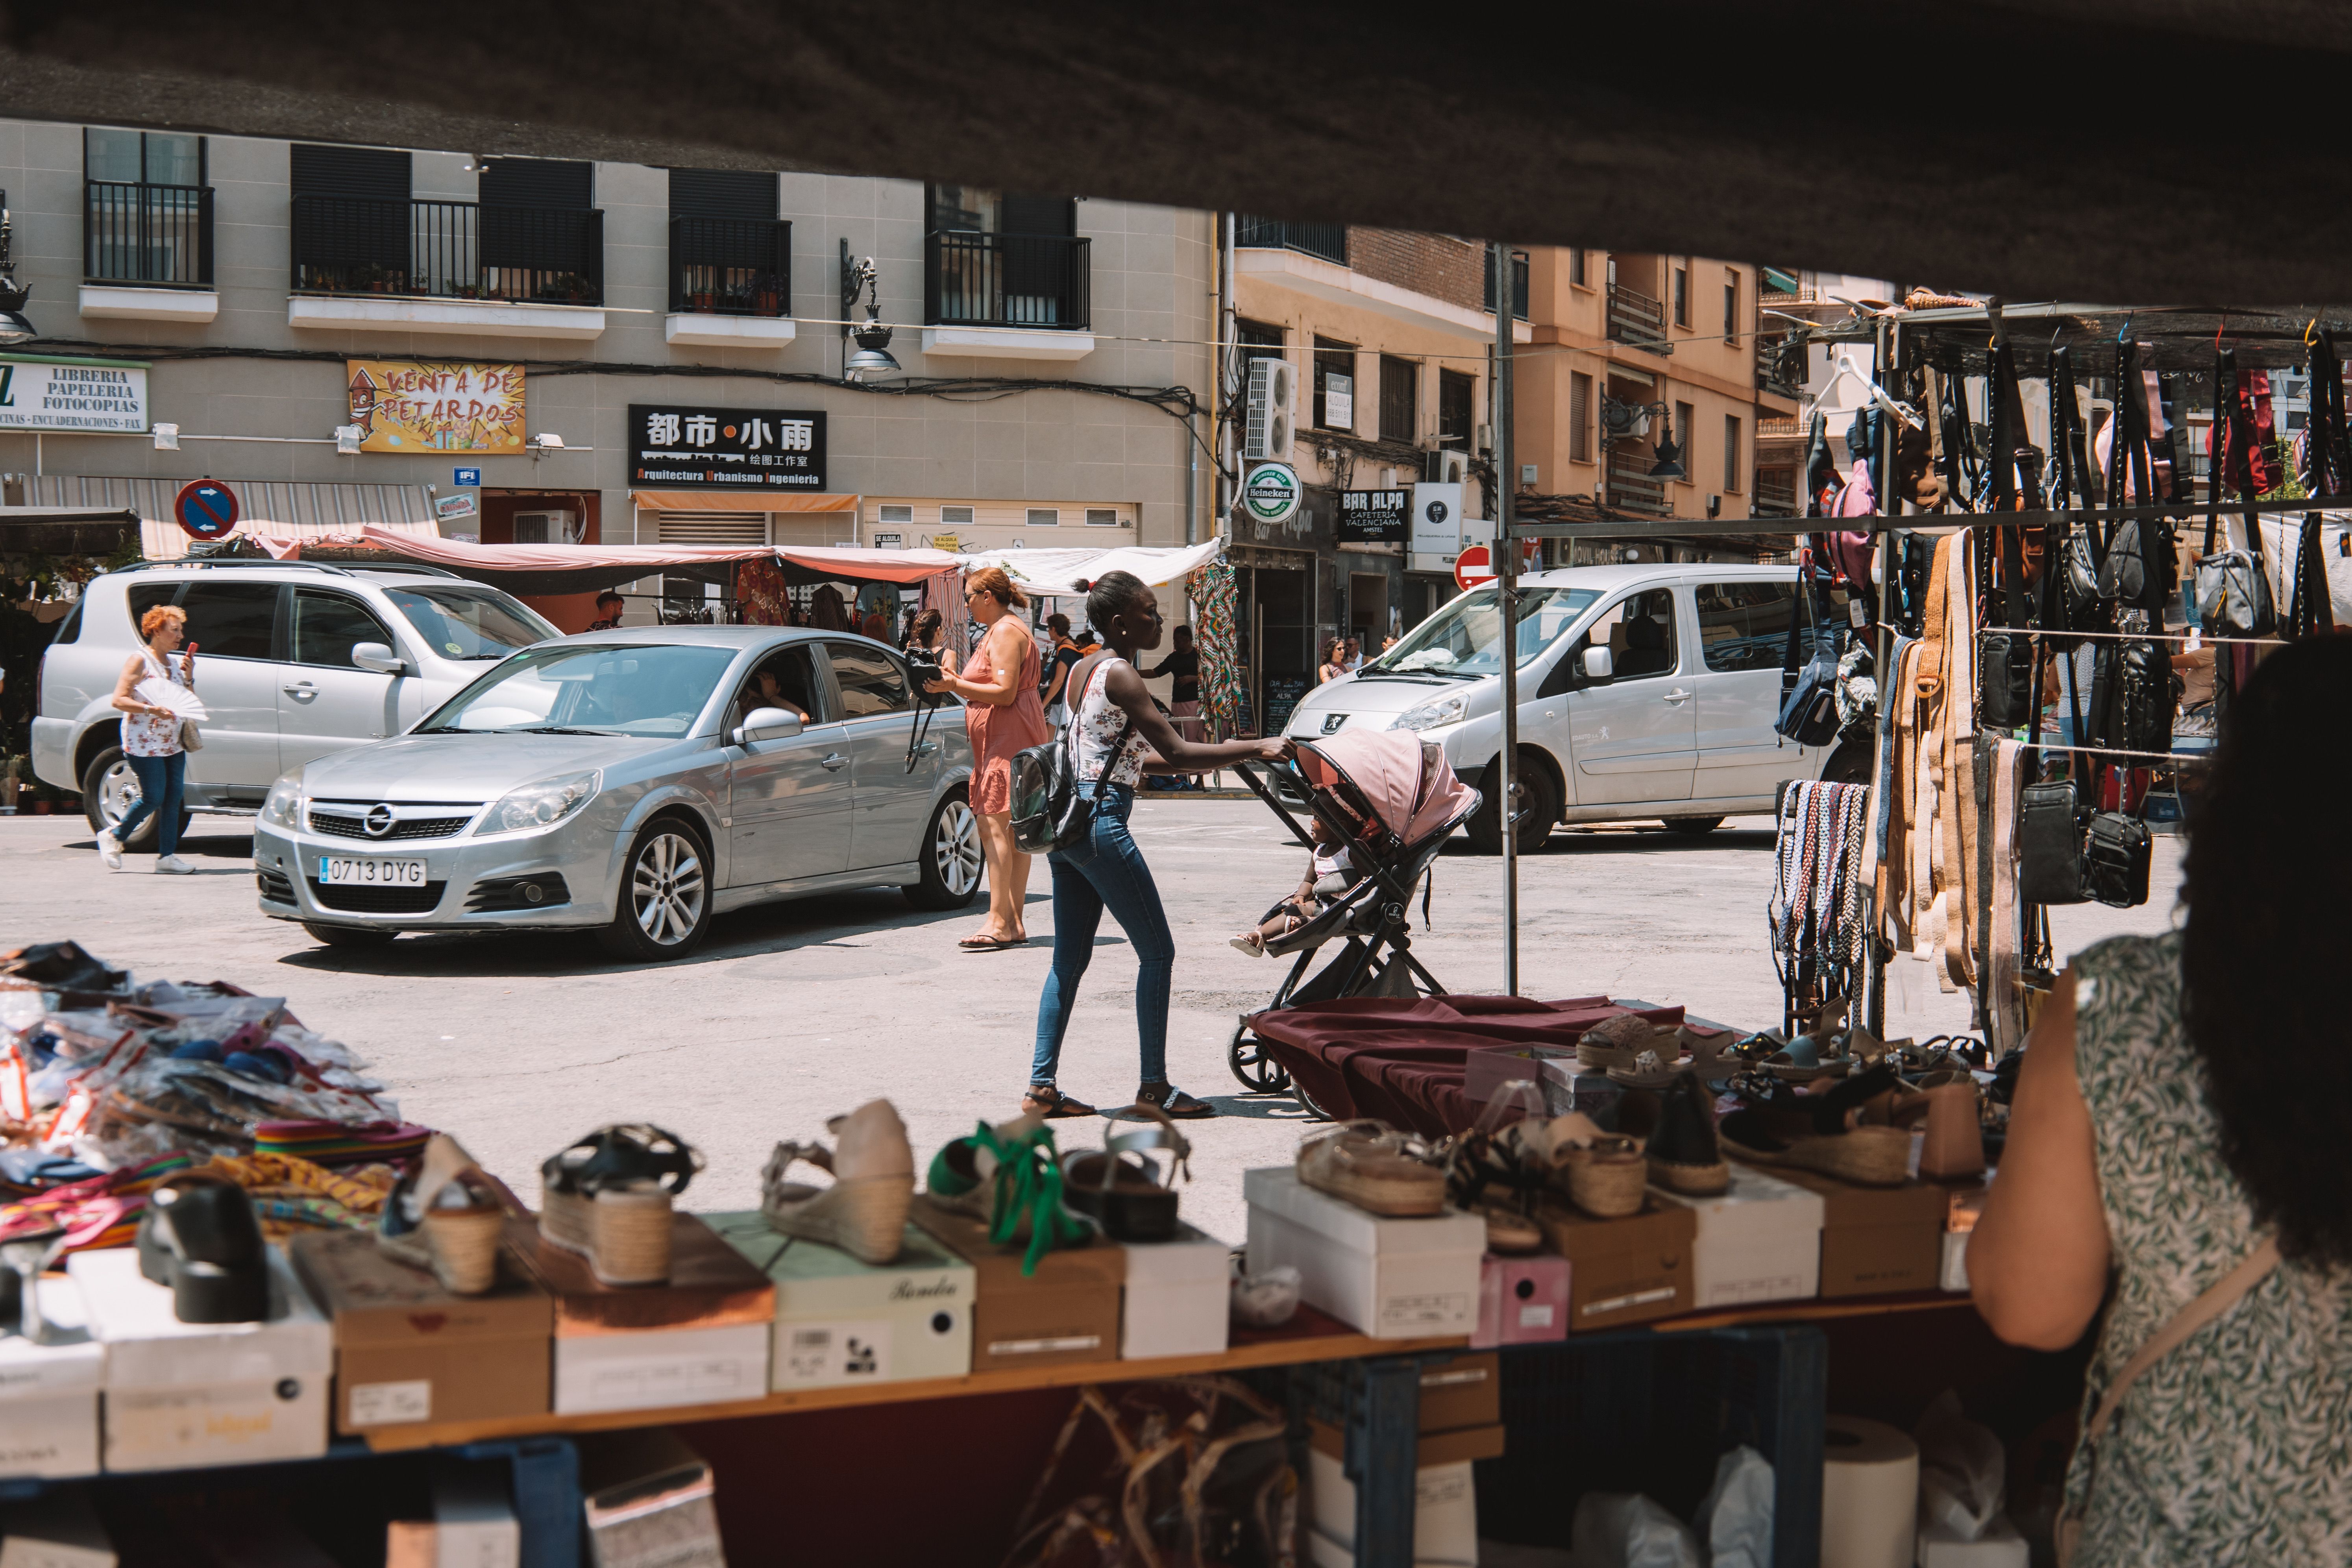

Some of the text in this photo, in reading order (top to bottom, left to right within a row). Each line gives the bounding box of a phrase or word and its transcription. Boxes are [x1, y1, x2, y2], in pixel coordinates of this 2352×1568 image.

[53, 368, 128, 383] LIBRERIA
[385, 369, 516, 394] VENTA DE
[48, 383, 133, 398] PAPELERIA
[43, 397, 138, 412] FOTOCOPIAS
[1328, 395, 1350, 408] ALQUILA
[382, 398, 521, 423] PETARDOS
[32, 415, 118, 427] ENCUADERNACIONES
[125, 419, 140, 429] FAX
[750, 454, 808, 466] 绘图工作室
[637, 468, 819, 485] Arquitectura Urbanismo Ingenieria
[1255, 472, 1287, 483] HEINEKEN BEER
[1250, 488, 1290, 497] Heineken
[1343, 492, 1404, 510] BAR ALPA
[1252, 503, 1270, 515] PREMIUM
[332, 861, 375, 880] 0713
[383, 862, 420, 882] DYG
